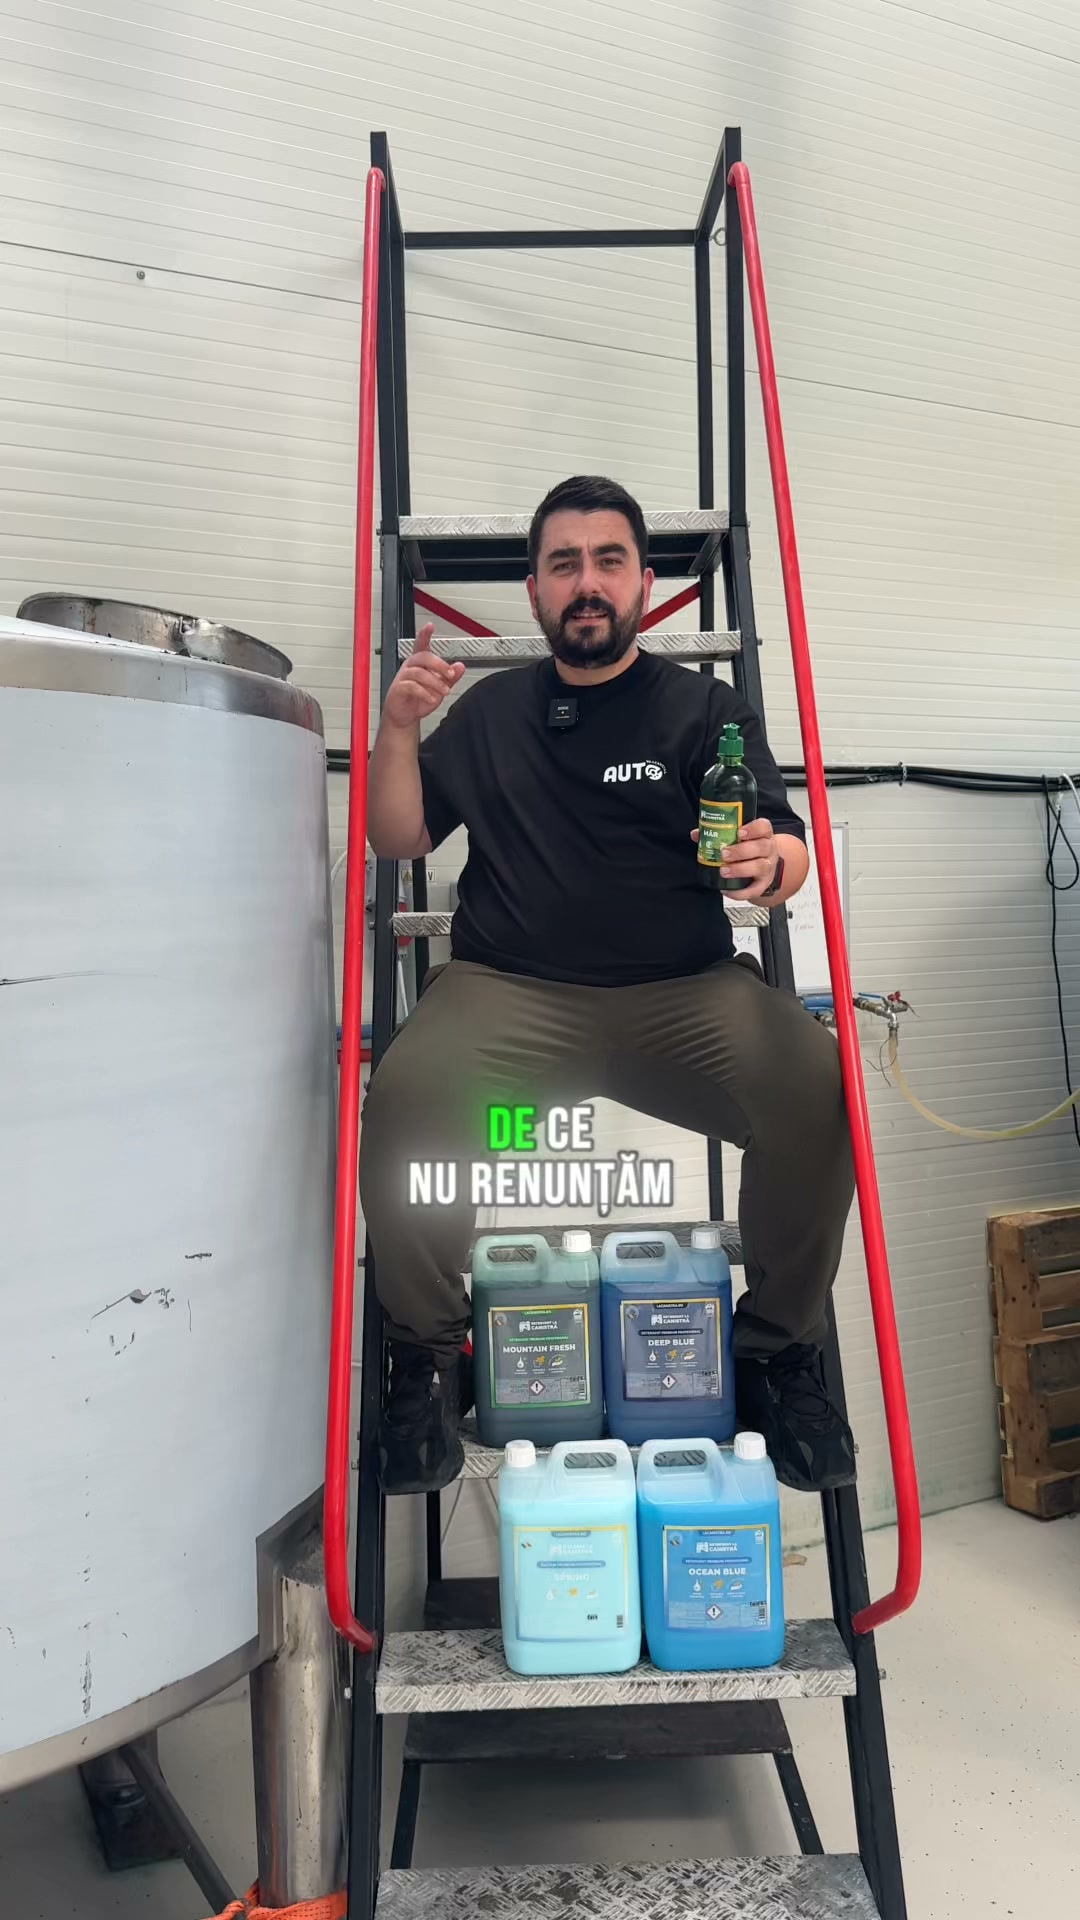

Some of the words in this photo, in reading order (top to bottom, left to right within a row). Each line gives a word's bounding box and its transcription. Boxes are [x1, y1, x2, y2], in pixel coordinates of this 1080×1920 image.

[672, 1338, 695, 1346] BLUE
[502, 1345, 548, 1353] MOUNTAIN
[549, 1343, 576, 1352] FRESH
[688, 1568, 721, 1576] OCEAN
[723, 1567, 746, 1575] BLUE
